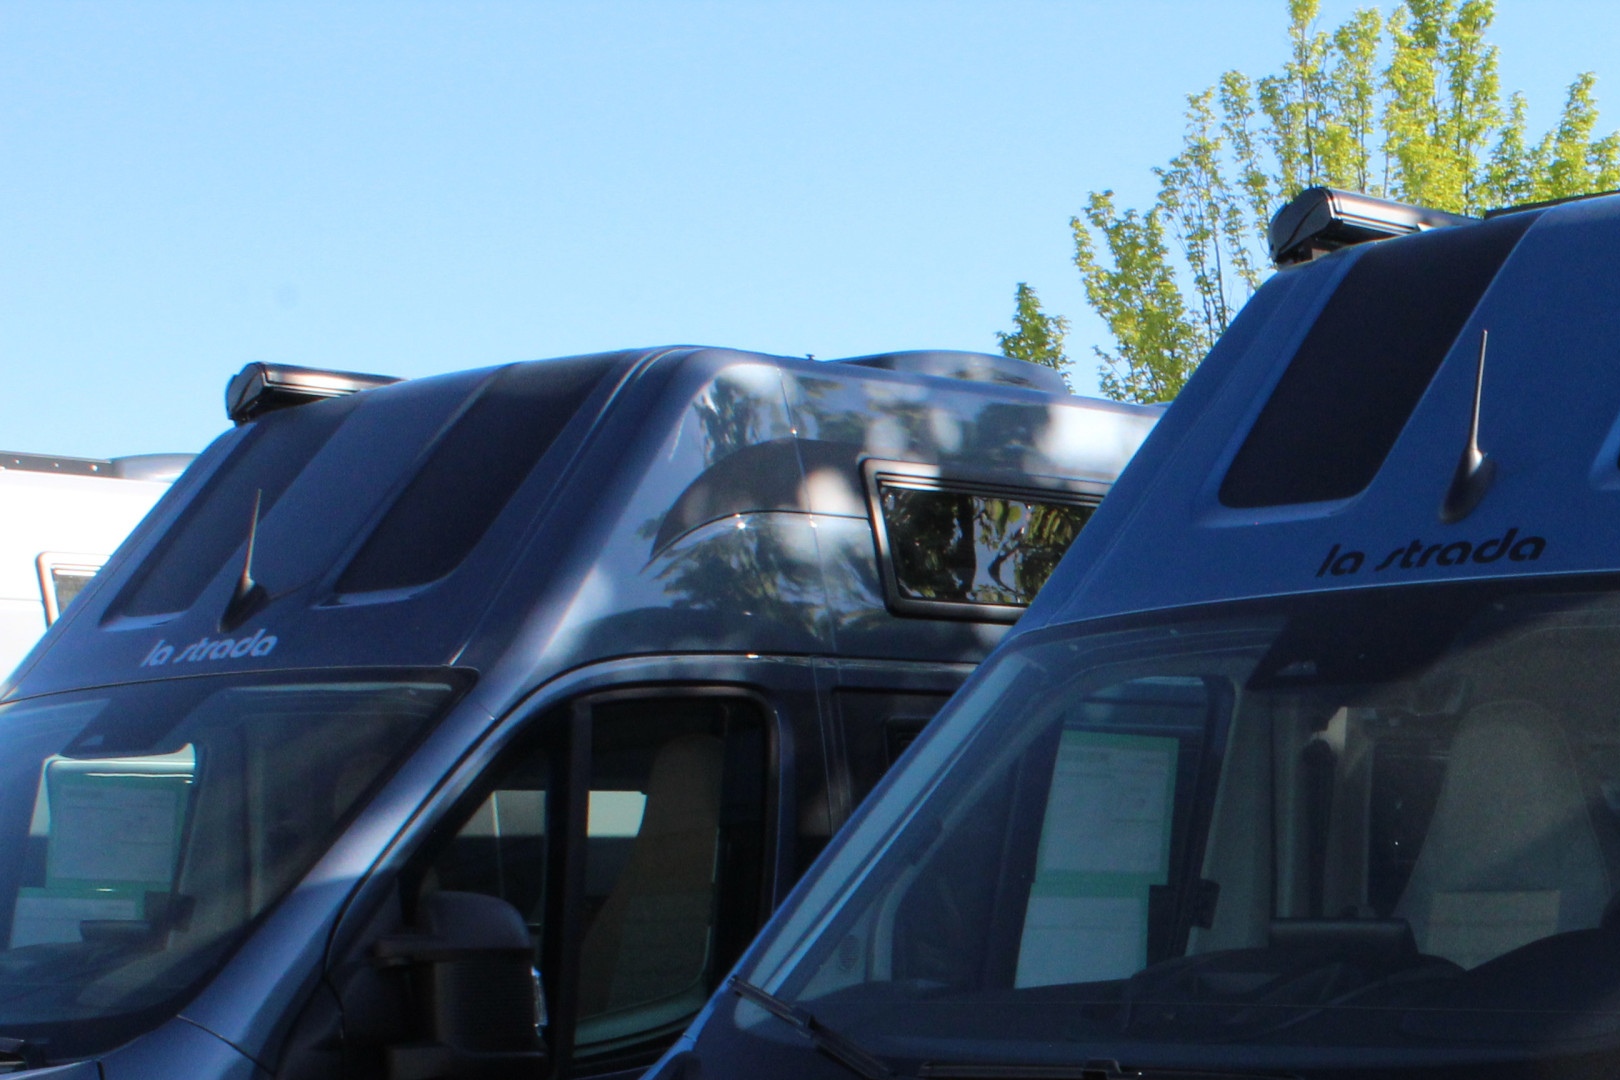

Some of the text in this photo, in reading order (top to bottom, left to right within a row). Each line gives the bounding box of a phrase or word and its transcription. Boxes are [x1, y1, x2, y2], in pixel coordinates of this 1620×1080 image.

[1315, 528, 1547, 578] la strada
[139, 628, 278, 668] la strada
